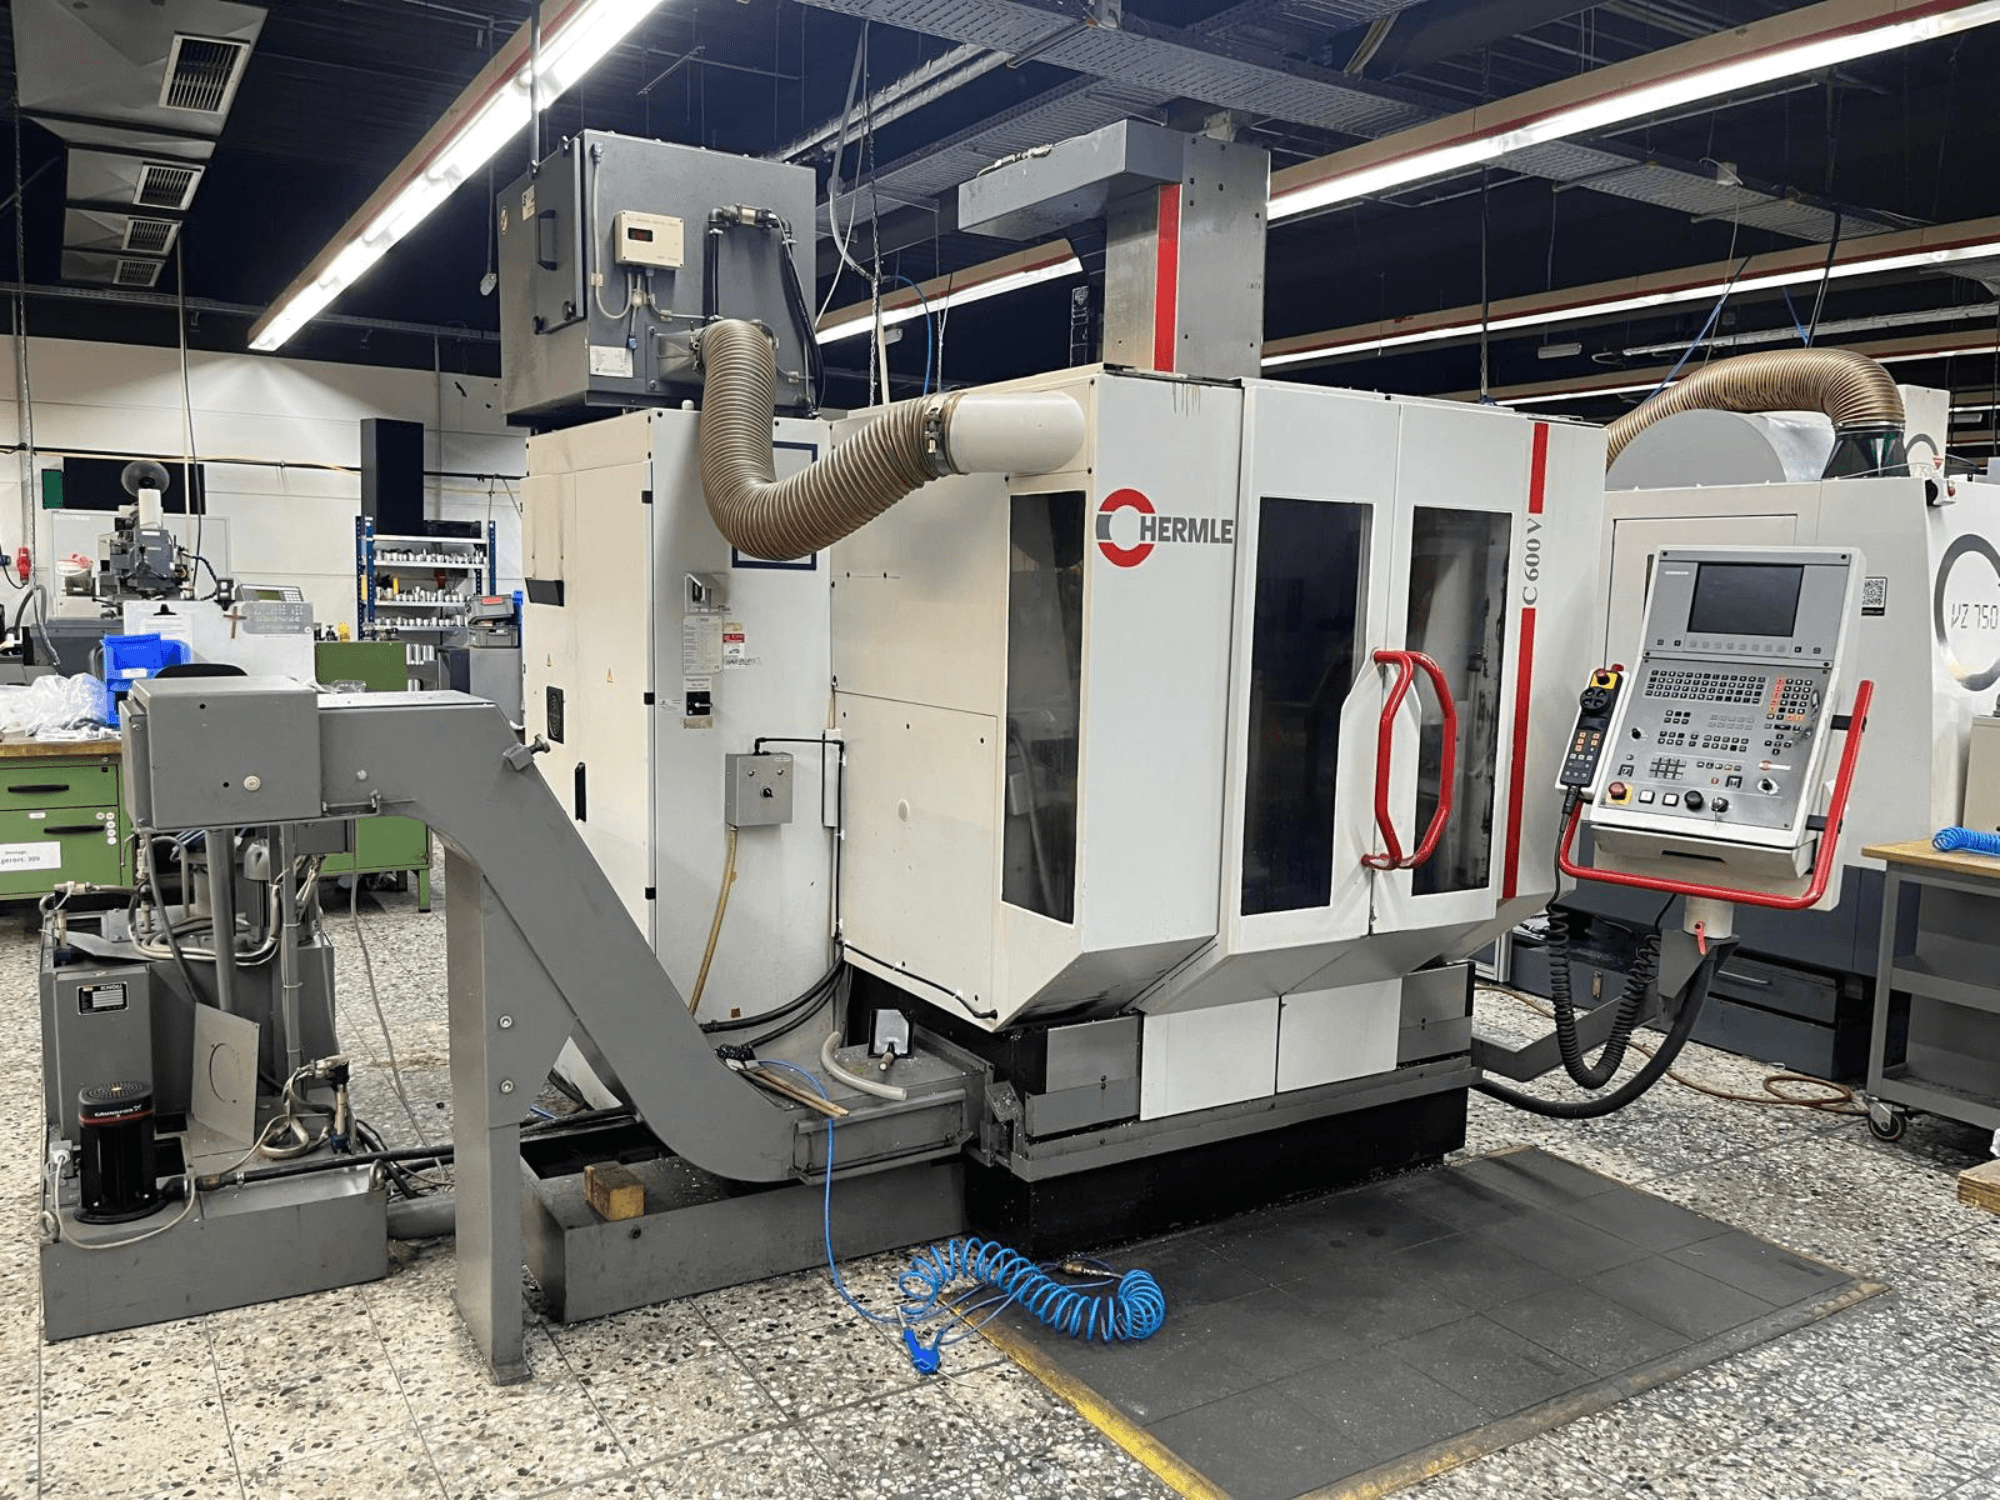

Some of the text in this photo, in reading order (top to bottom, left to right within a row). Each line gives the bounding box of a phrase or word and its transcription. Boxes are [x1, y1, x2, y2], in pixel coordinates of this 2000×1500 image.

[1140, 516, 1234, 544] HERMLE
[1522, 518, 1542, 605] C 600 V
[1974, 604, 1999, 630] 750
